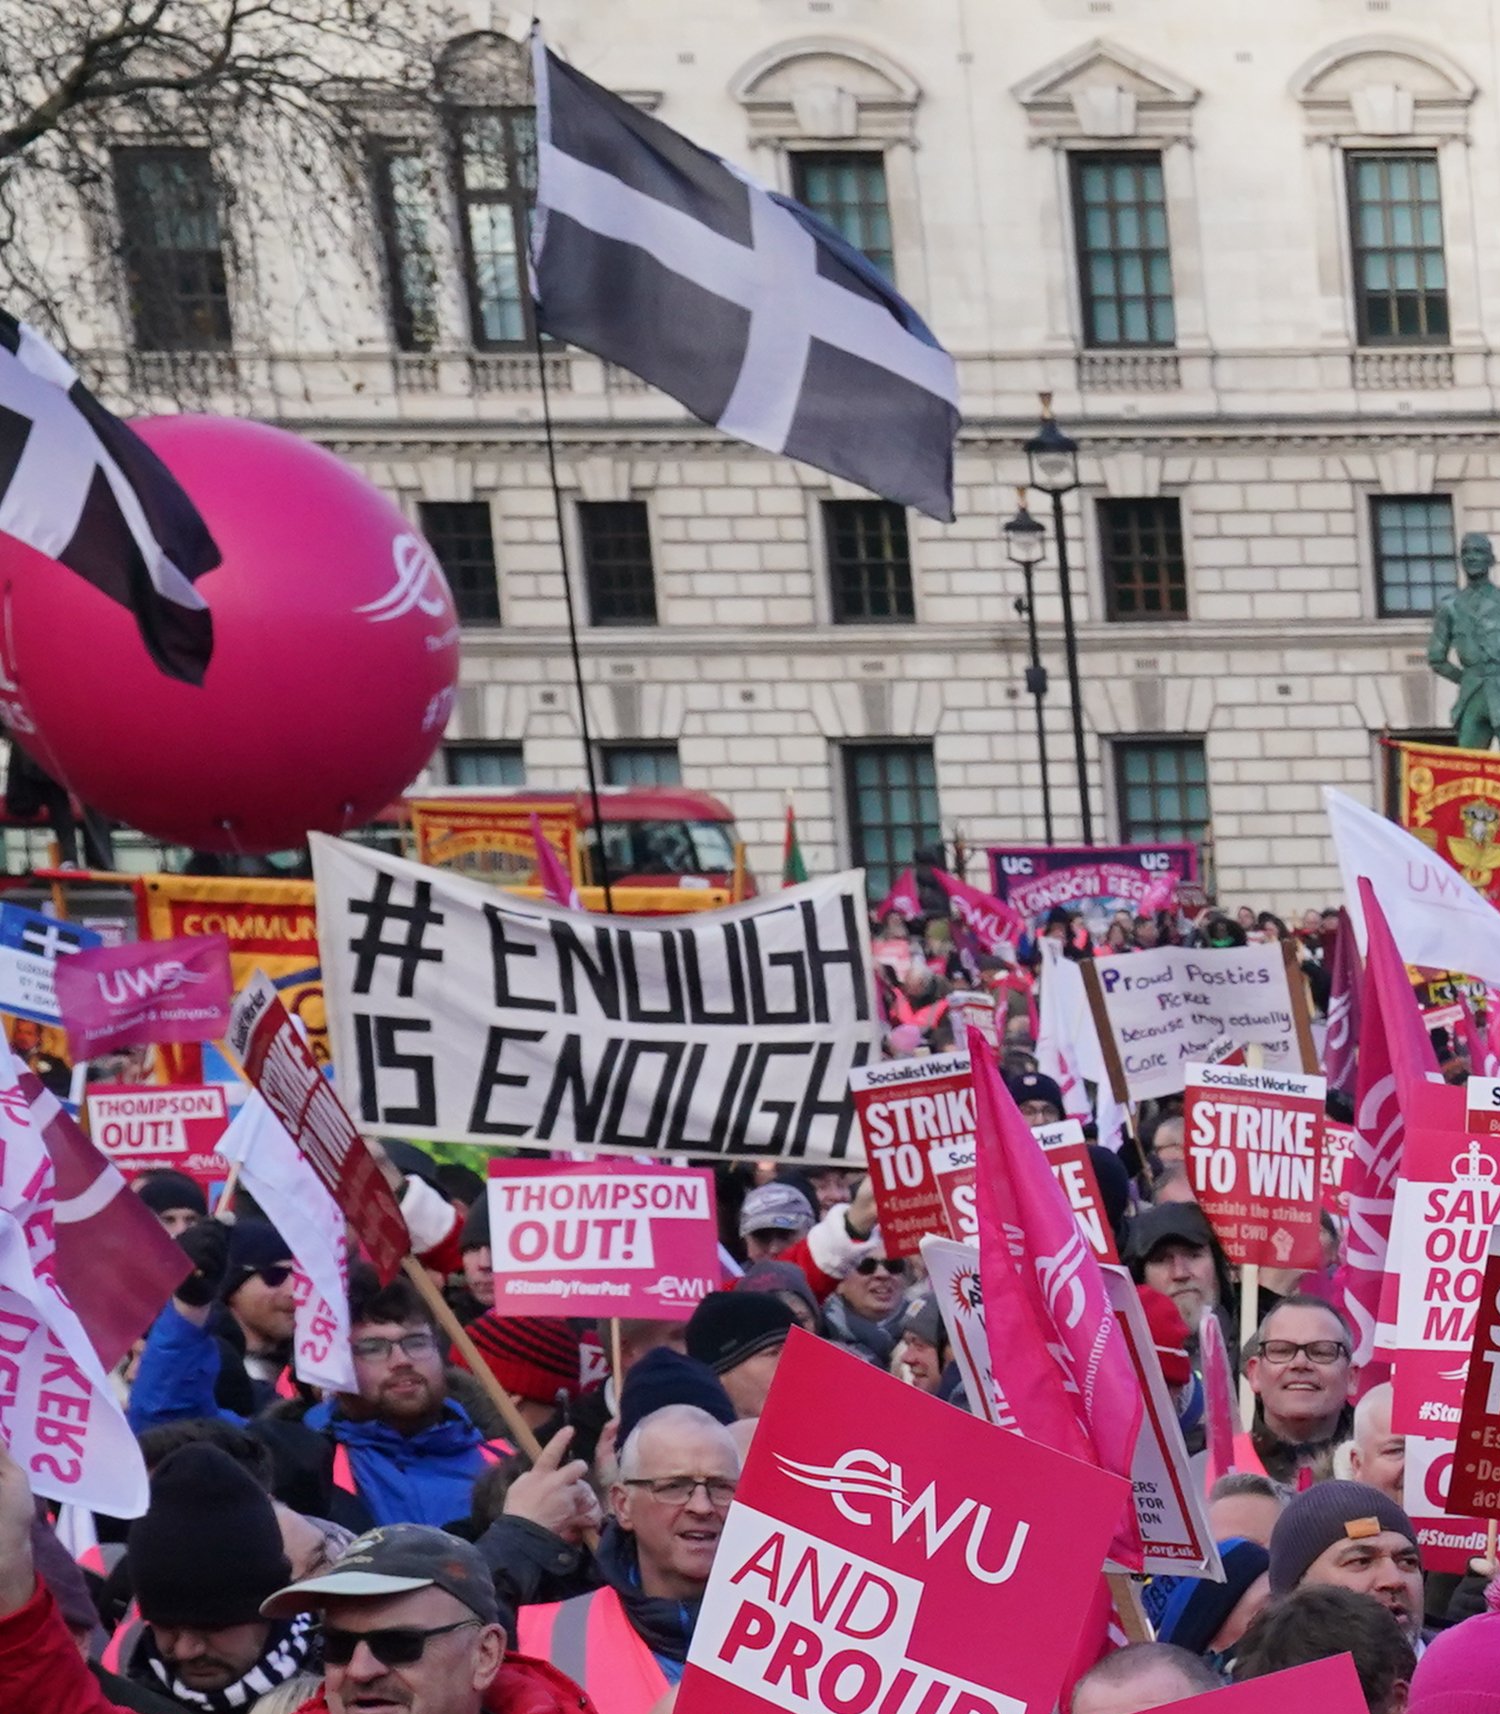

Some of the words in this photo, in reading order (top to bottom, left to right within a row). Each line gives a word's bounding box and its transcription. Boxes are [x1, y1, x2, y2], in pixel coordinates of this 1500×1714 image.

[1017, 876, 1101, 914] LONDON
[349, 874, 444, 998] #
[484, 895, 869, 1024] ENOUGH
[1101, 967, 1173, 993] Proud
[1187, 964, 1269, 986] Posties
[1121, 1018, 1184, 1041] because
[354, 1014, 437, 1125] IS
[470, 1028, 870, 1159] ENOUGH
[1125, 1056, 1167, 1074] Care
[102, 1121, 174, 1147] OUT!
[1191, 1101, 1316, 1154] STRIKE
[1189, 1147, 1238, 1193] TO
[1248, 1154, 1314, 1201] WIN
[502, 1182, 700, 1214] THOMPSON
[508, 1218, 637, 1263] OUT!
[833, 1448, 1030, 1584] CWU
[730, 1531, 900, 1641] AND
